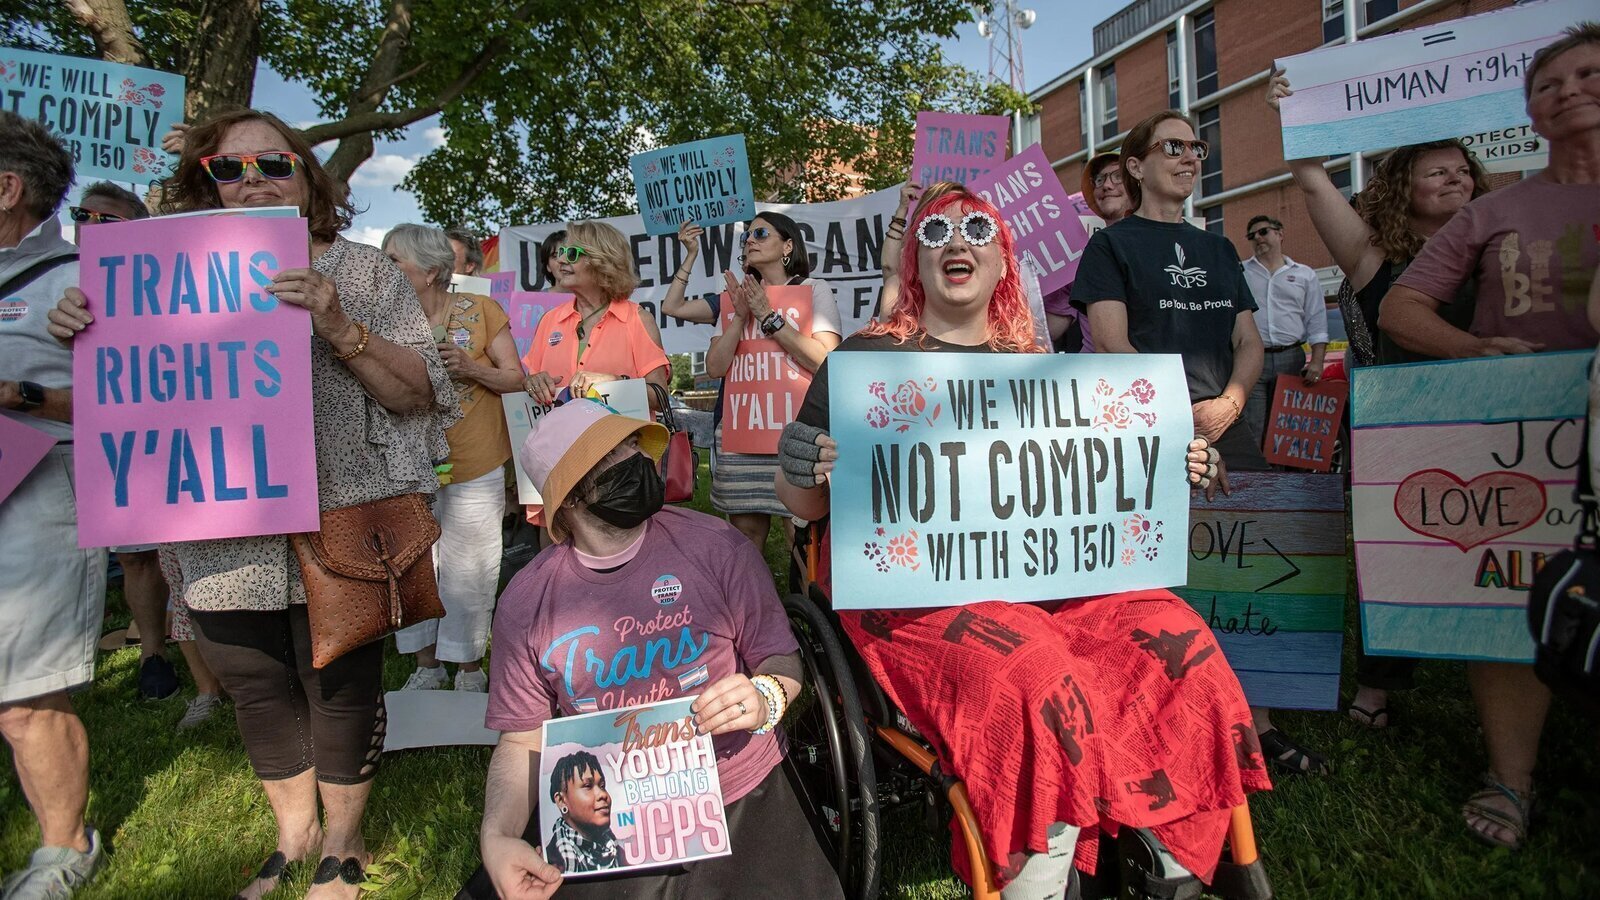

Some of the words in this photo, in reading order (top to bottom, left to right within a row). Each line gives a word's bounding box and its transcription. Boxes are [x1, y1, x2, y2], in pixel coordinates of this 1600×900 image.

[20, 62, 52, 90] WE
[62, 67, 113, 99] WILL
[1345, 64, 1450, 112] HUMAN
[1464, 51, 1533, 84] right
[38, 94, 160, 148] COMPLY
[1460, 124, 1530, 147] OTECT
[90, 142, 126, 171] 150
[925, 126, 997, 159] TRANS
[1486, 141, 1536, 159] KIDS
[660, 155, 677, 176] WE
[678, 149, 709, 172] WILL
[920, 164, 992, 188] RIGHT
[644, 179, 670, 210] NOT
[674, 166, 738, 204] COMPLY
[976, 161, 1043, 211] RANS
[662, 206, 686, 226] WITH
[687, 203, 703, 221] SB
[704, 200, 725, 220] 150
[1018, 230, 1083, 278] ALL
[99, 250, 281, 318] TRANS
[1169, 272, 1208, 289] JCPS
[1159, 299, 1173, 309] Be
[1173, 299, 1189, 311] You.
[1189, 302, 1203, 311] Be
[96, 340, 283, 405] RIGHTS
[730, 351, 800, 383] RIGHTS
[946, 378, 999, 430] WE
[1008, 377, 1091, 430] WILL
[1283, 388, 1338, 415] TRANS
[1275, 411, 1332, 436] RIGHTS
[1273, 432, 1324, 462] Y'ALL
[1482, 418, 1582, 470] JC
[100, 424, 289, 508] Y'ALL
[871, 440, 966, 524] NOT
[988, 435, 1161, 521] COMPLY
[1420, 486, 1520, 527] LOVE
[926, 529, 1010, 582] WITH
[1023, 526, 1059, 577] SB
[1070, 521, 1116, 574] 150
[1189, 520, 1258, 570] OVE
[654, 585, 680, 594] PROTECT
[657, 591, 677, 599] TRANS
[660, 596, 675, 604] KIDS
[613, 604, 694, 642] Protect
[1208, 595, 1279, 637] hate
[540, 626, 710, 697] Trans
[602, 677, 674, 710] Youth
[613, 707, 697, 754] Trans
[605, 736, 716, 783] YOUTH
[623, 767, 710, 806] BELONG
[617, 811, 635, 828] IN
[624, 793, 727, 866] JCPS
